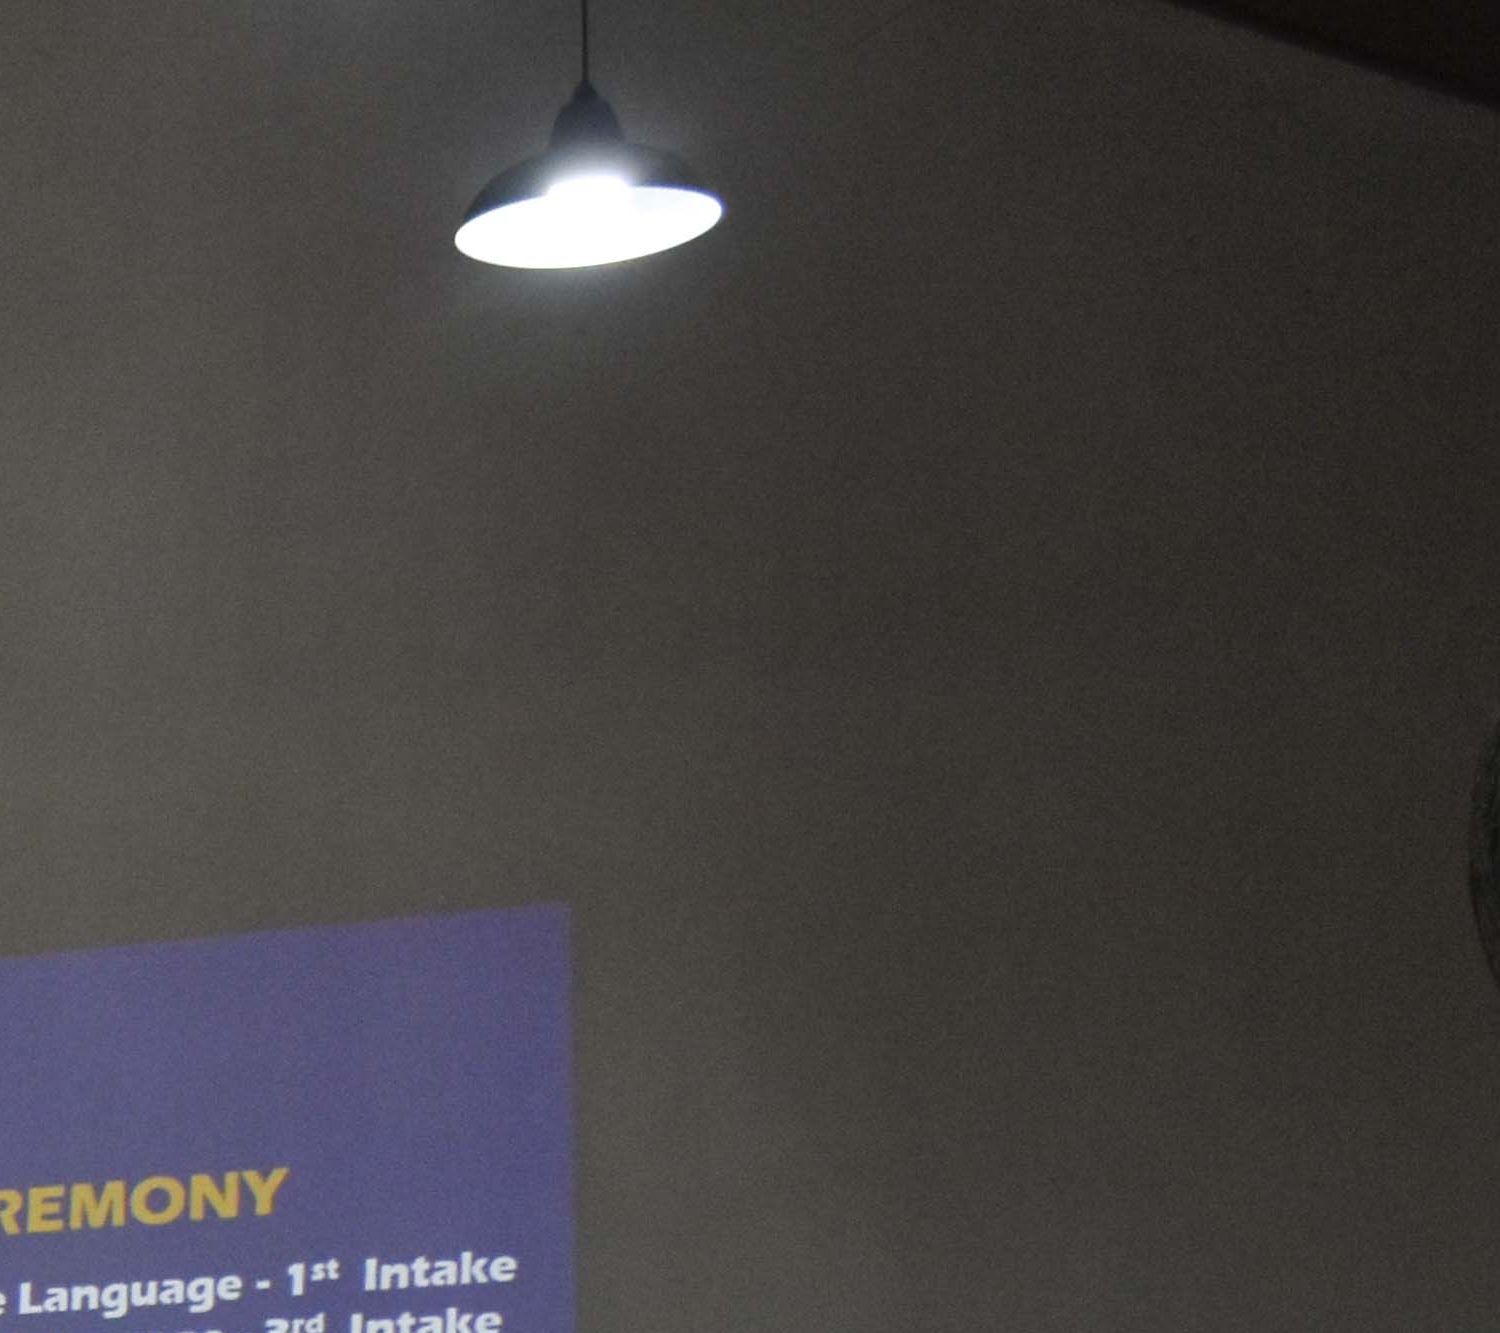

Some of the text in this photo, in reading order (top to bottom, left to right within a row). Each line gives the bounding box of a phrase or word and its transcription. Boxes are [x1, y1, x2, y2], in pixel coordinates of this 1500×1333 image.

[19, 1275, 243, 1318] Language
[287, 1258, 339, 1296] 1st
[365, 1251, 518, 1291] Intake
